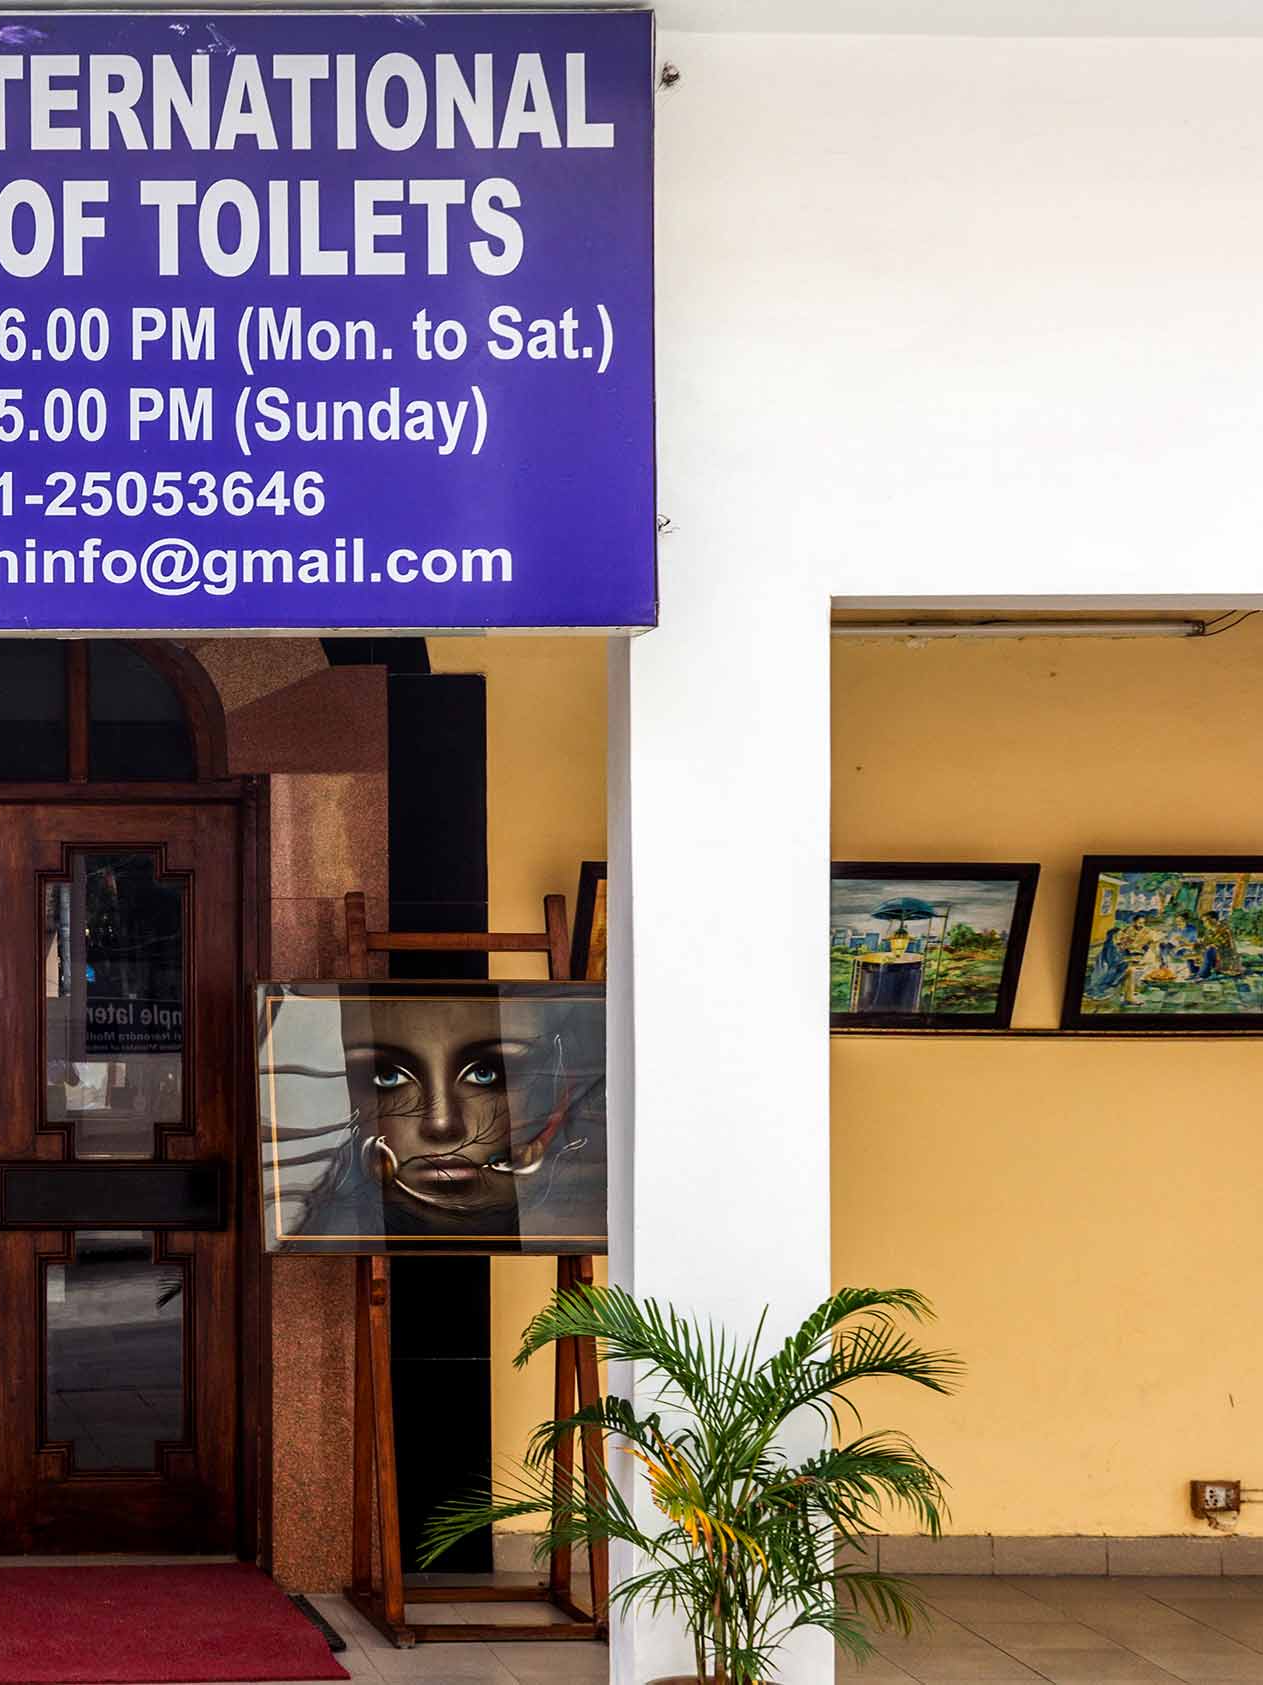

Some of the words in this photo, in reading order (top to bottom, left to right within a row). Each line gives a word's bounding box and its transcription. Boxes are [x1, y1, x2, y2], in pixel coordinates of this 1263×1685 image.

[140, 177, 524, 278] TOILETS
[132, 307, 216, 361] PM
[237, 306, 393, 376] (Mon.
[412, 308, 468, 361] to
[487, 304, 614, 374] Sat.)
[129, 387, 213, 441] PM
[235, 385, 488, 456] (Sunday)
